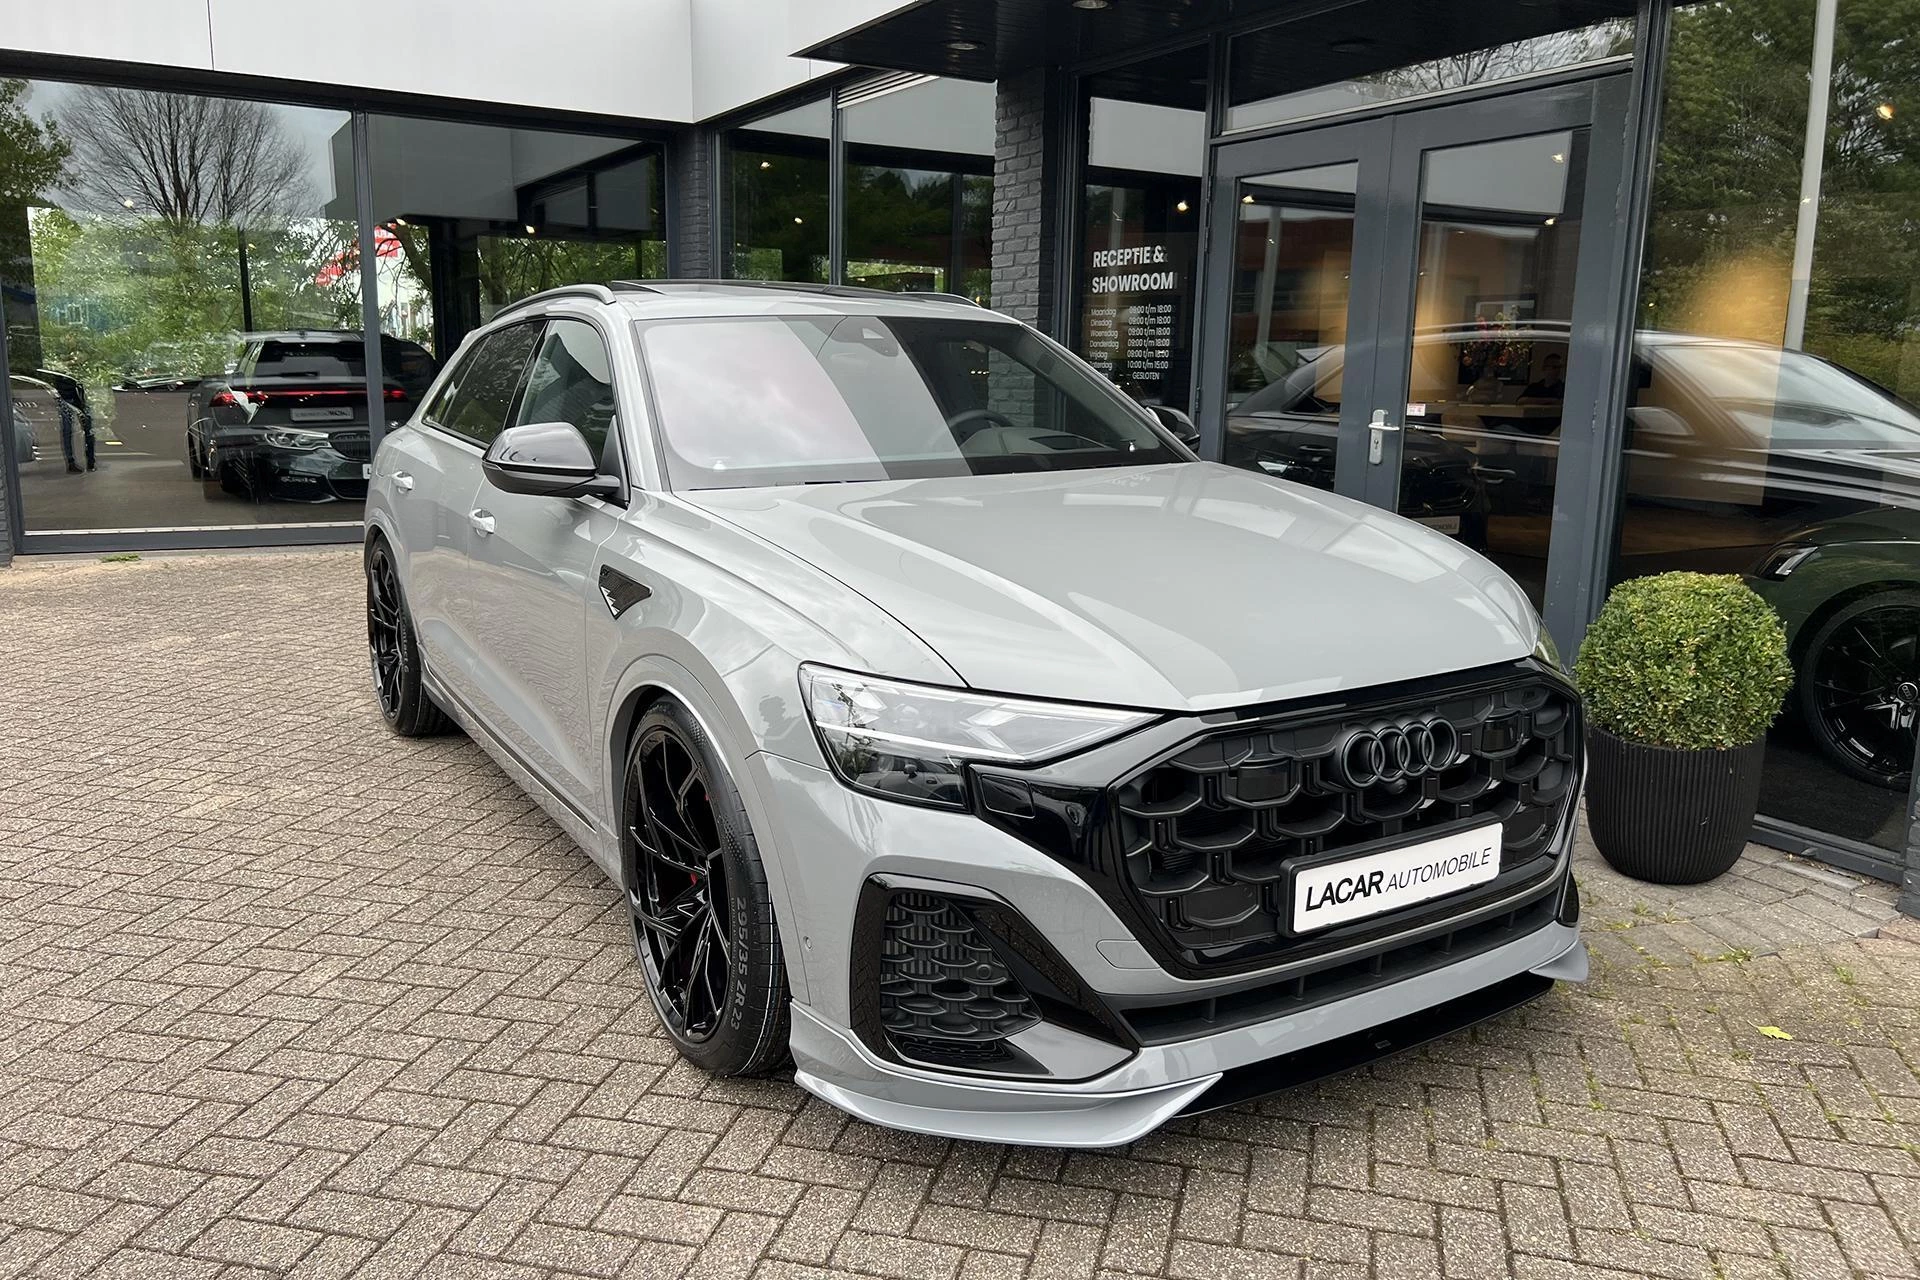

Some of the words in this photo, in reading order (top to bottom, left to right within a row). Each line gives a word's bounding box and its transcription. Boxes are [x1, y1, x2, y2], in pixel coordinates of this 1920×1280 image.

[1093, 246, 1151, 268] RECEPTIE
[1153, 245, 1164, 263] &
[1092, 272, 1174, 293] SHOWROOM
[1091, 308, 1117, 317] Maandag
[1090, 319, 1112, 328] Dinsdag
[1090, 330, 1119, 338] Woensdag
[1089, 340, 1119, 349] Donderdag
[1132, 371, 1160, 380] GESLOTEN
[1305, 870, 1384, 912] LACAR
[1386, 847, 1492, 893] AUTOMOBILE
[737, 897, 748, 976] 295/35
[735, 980, 746, 1007] ZR
[731, 1007, 742, 1030] 23
